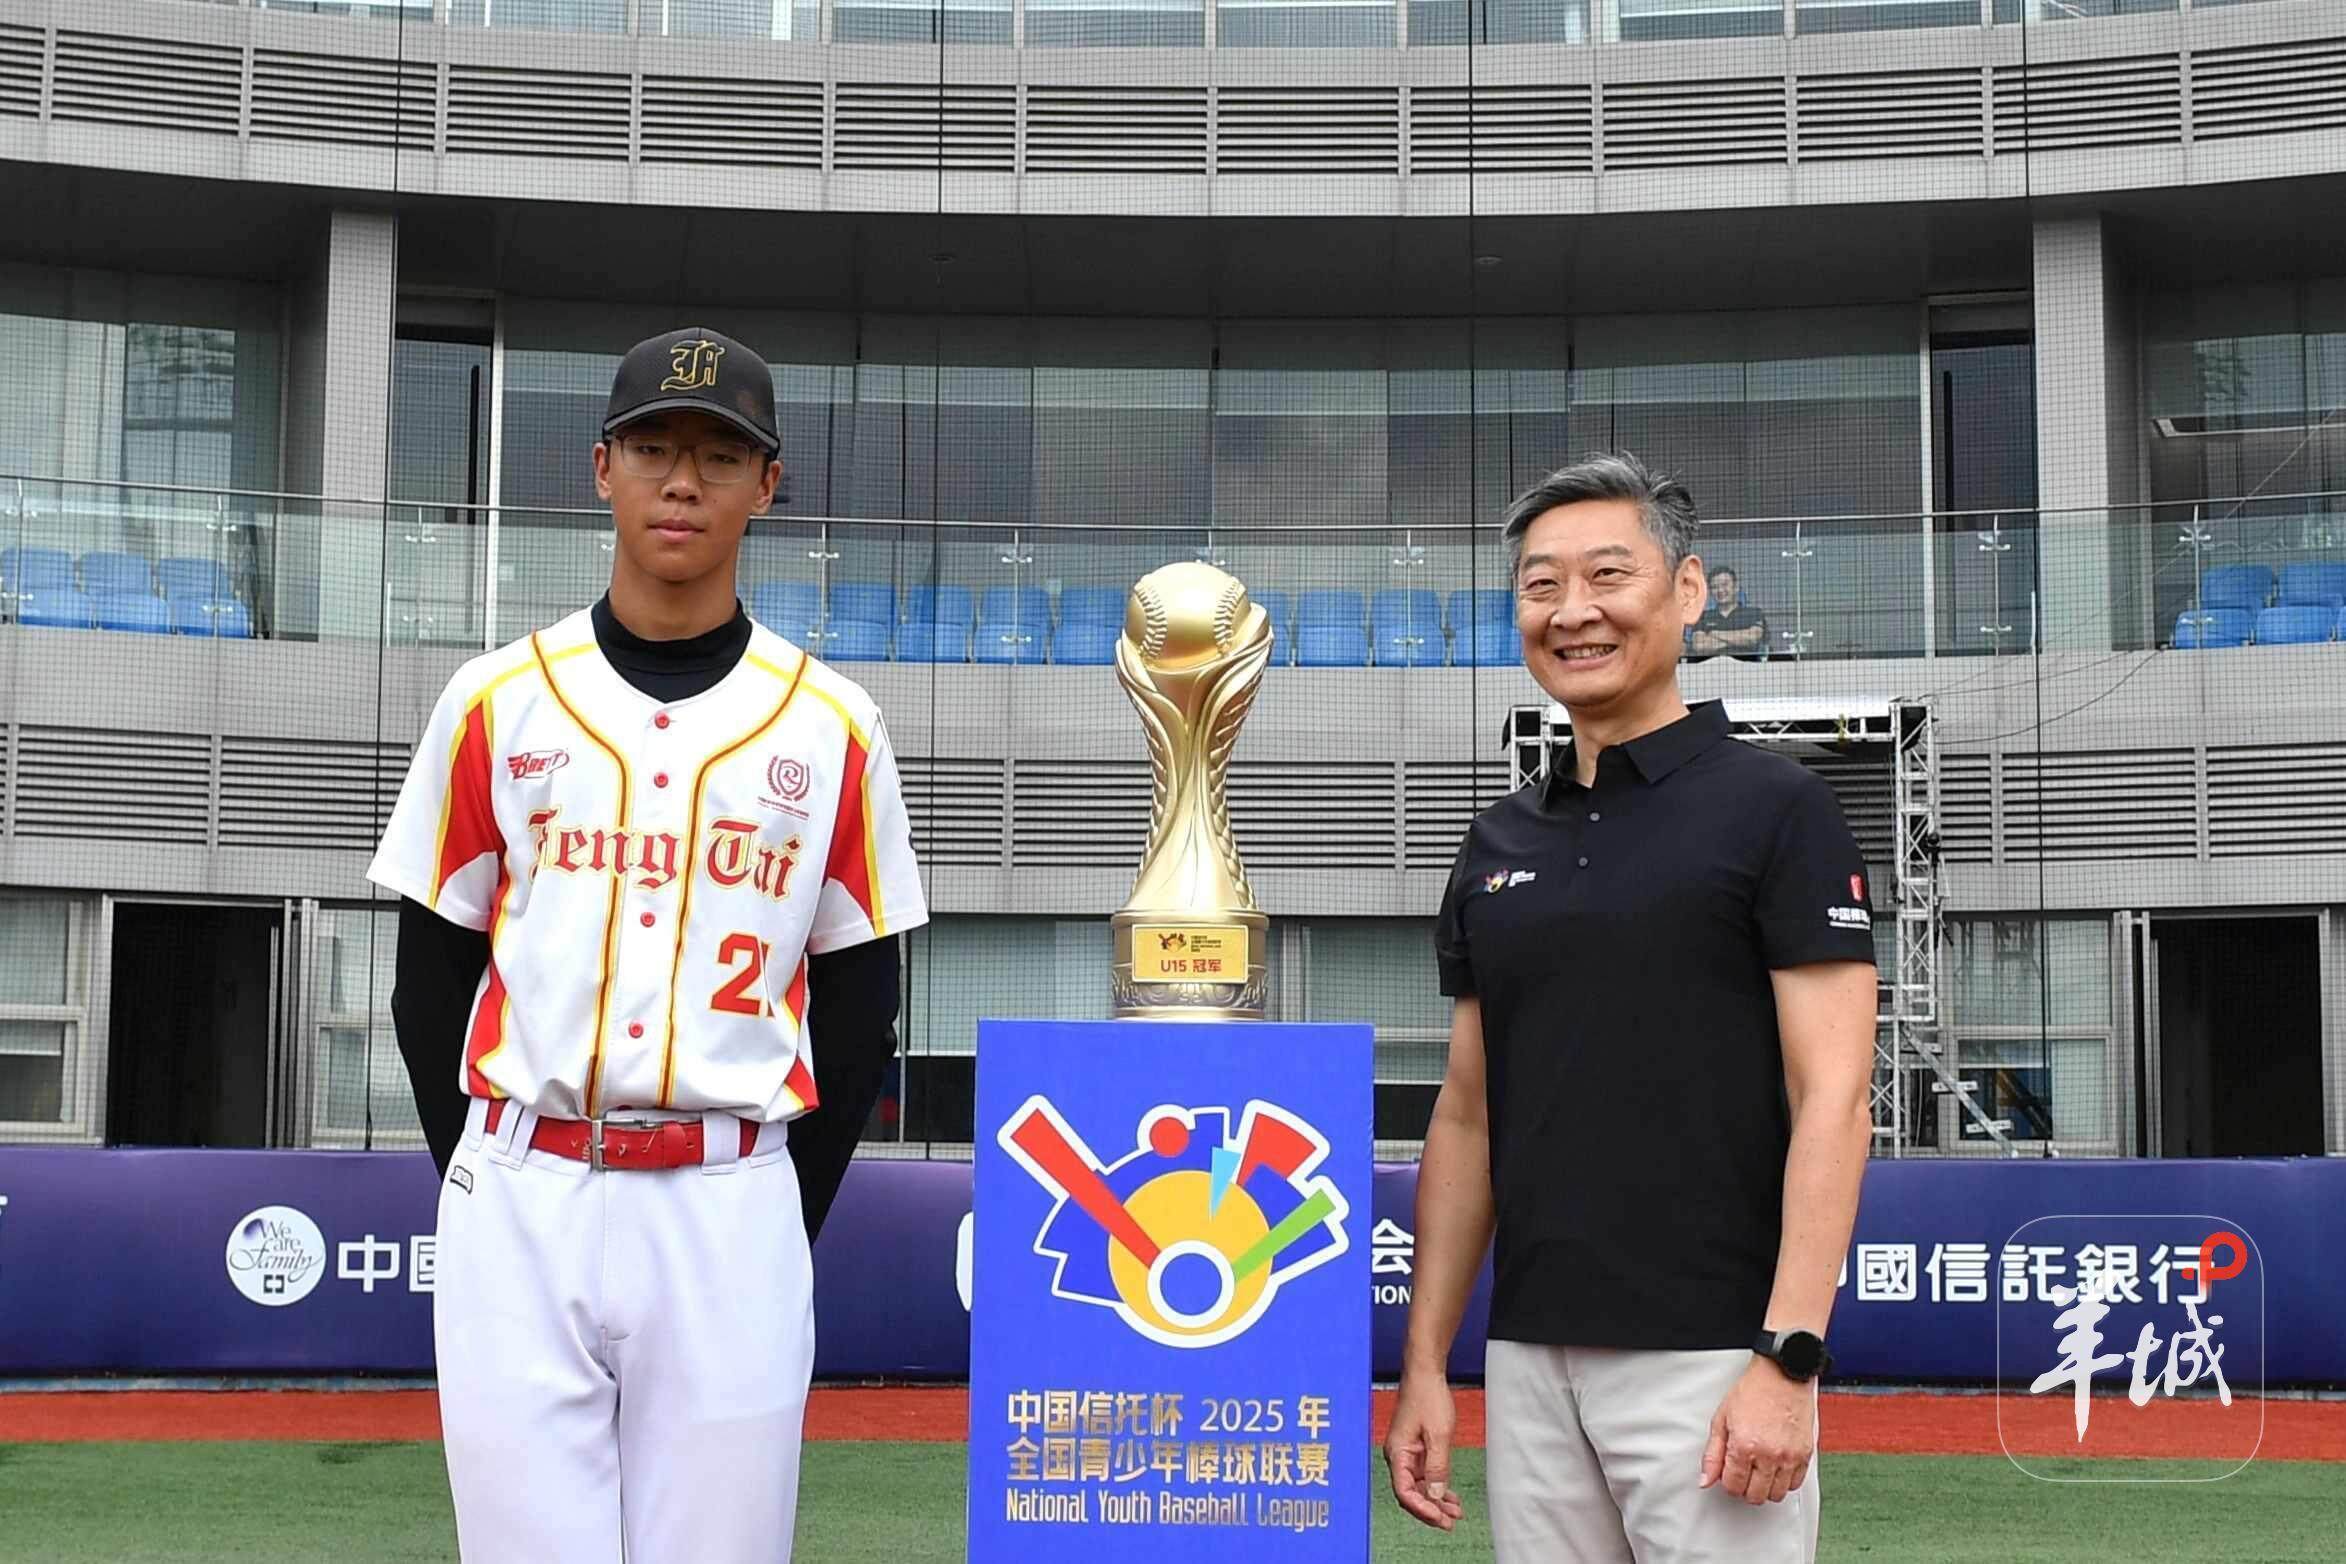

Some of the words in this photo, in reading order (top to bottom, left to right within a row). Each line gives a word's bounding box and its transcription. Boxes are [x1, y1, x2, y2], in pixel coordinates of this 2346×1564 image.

[1160, 959, 1187, 973] U15
[1007, 1389, 1184, 1437] 中国信托杯
[1199, 1398, 1285, 1432] 2025
[1296, 1395, 1331, 1439] 年
[1006, 1436, 1331, 1487] 全国青少年棒球联赛
[1006, 1487, 1089, 1523] National
[1098, 1489, 1151, 1525] Youth
[1159, 1490, 1249, 1527] Baseball
[1256, 1492, 1329, 1533] League
